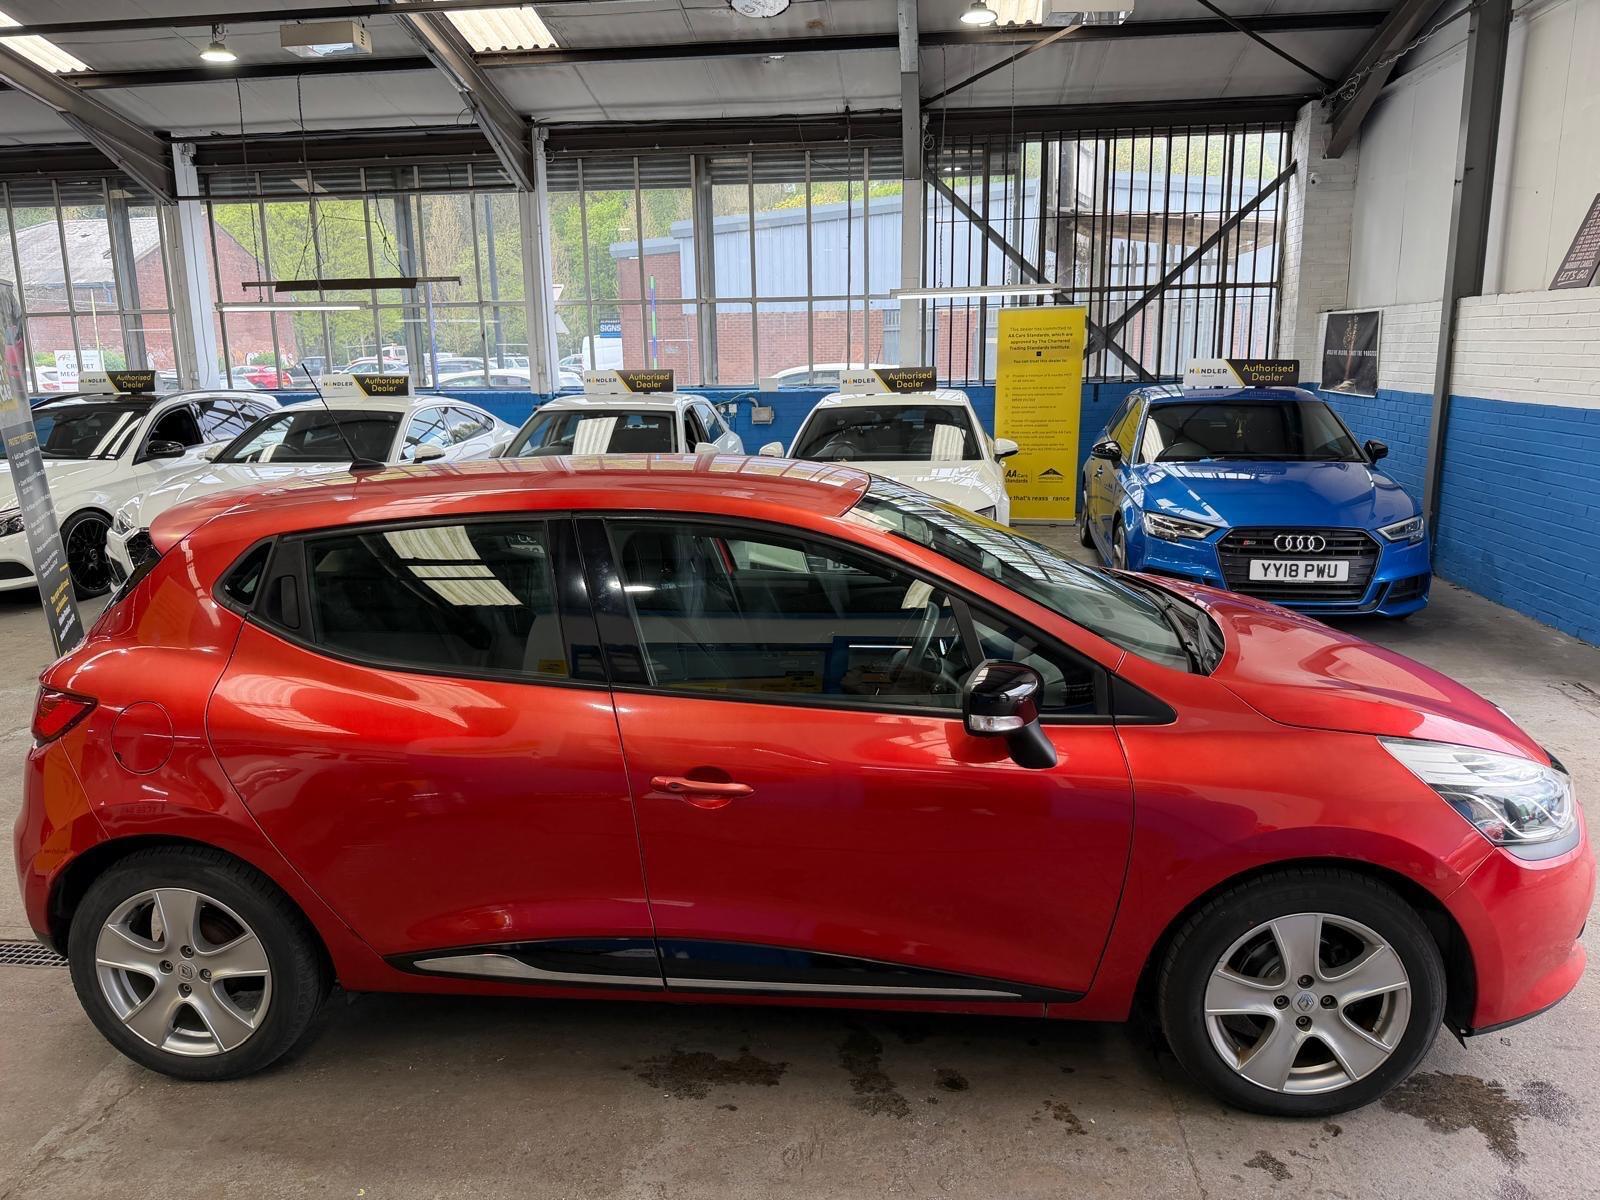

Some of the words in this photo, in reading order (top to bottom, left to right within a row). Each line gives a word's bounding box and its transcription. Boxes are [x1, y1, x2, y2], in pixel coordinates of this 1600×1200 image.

[1557, 270, 1578, 282] LET'S
[600, 324, 621, 332] SIGNS
[1243, 363, 1294, 373] Authorised
[628, 373, 670, 381] Authorised
[888, 371, 932, 380] Authorised
[1251, 373, 1284, 382] Dealer
[122, 381, 145, 389] Dealer
[371, 384, 397, 392] Dealer
[636, 380, 662, 388] Dealer
[896, 380, 924, 389] Dealer
[1005, 469, 1017, 478] AA
[1261, 563, 1299, 578] YY18
[1304, 563, 1338, 578] PWU
